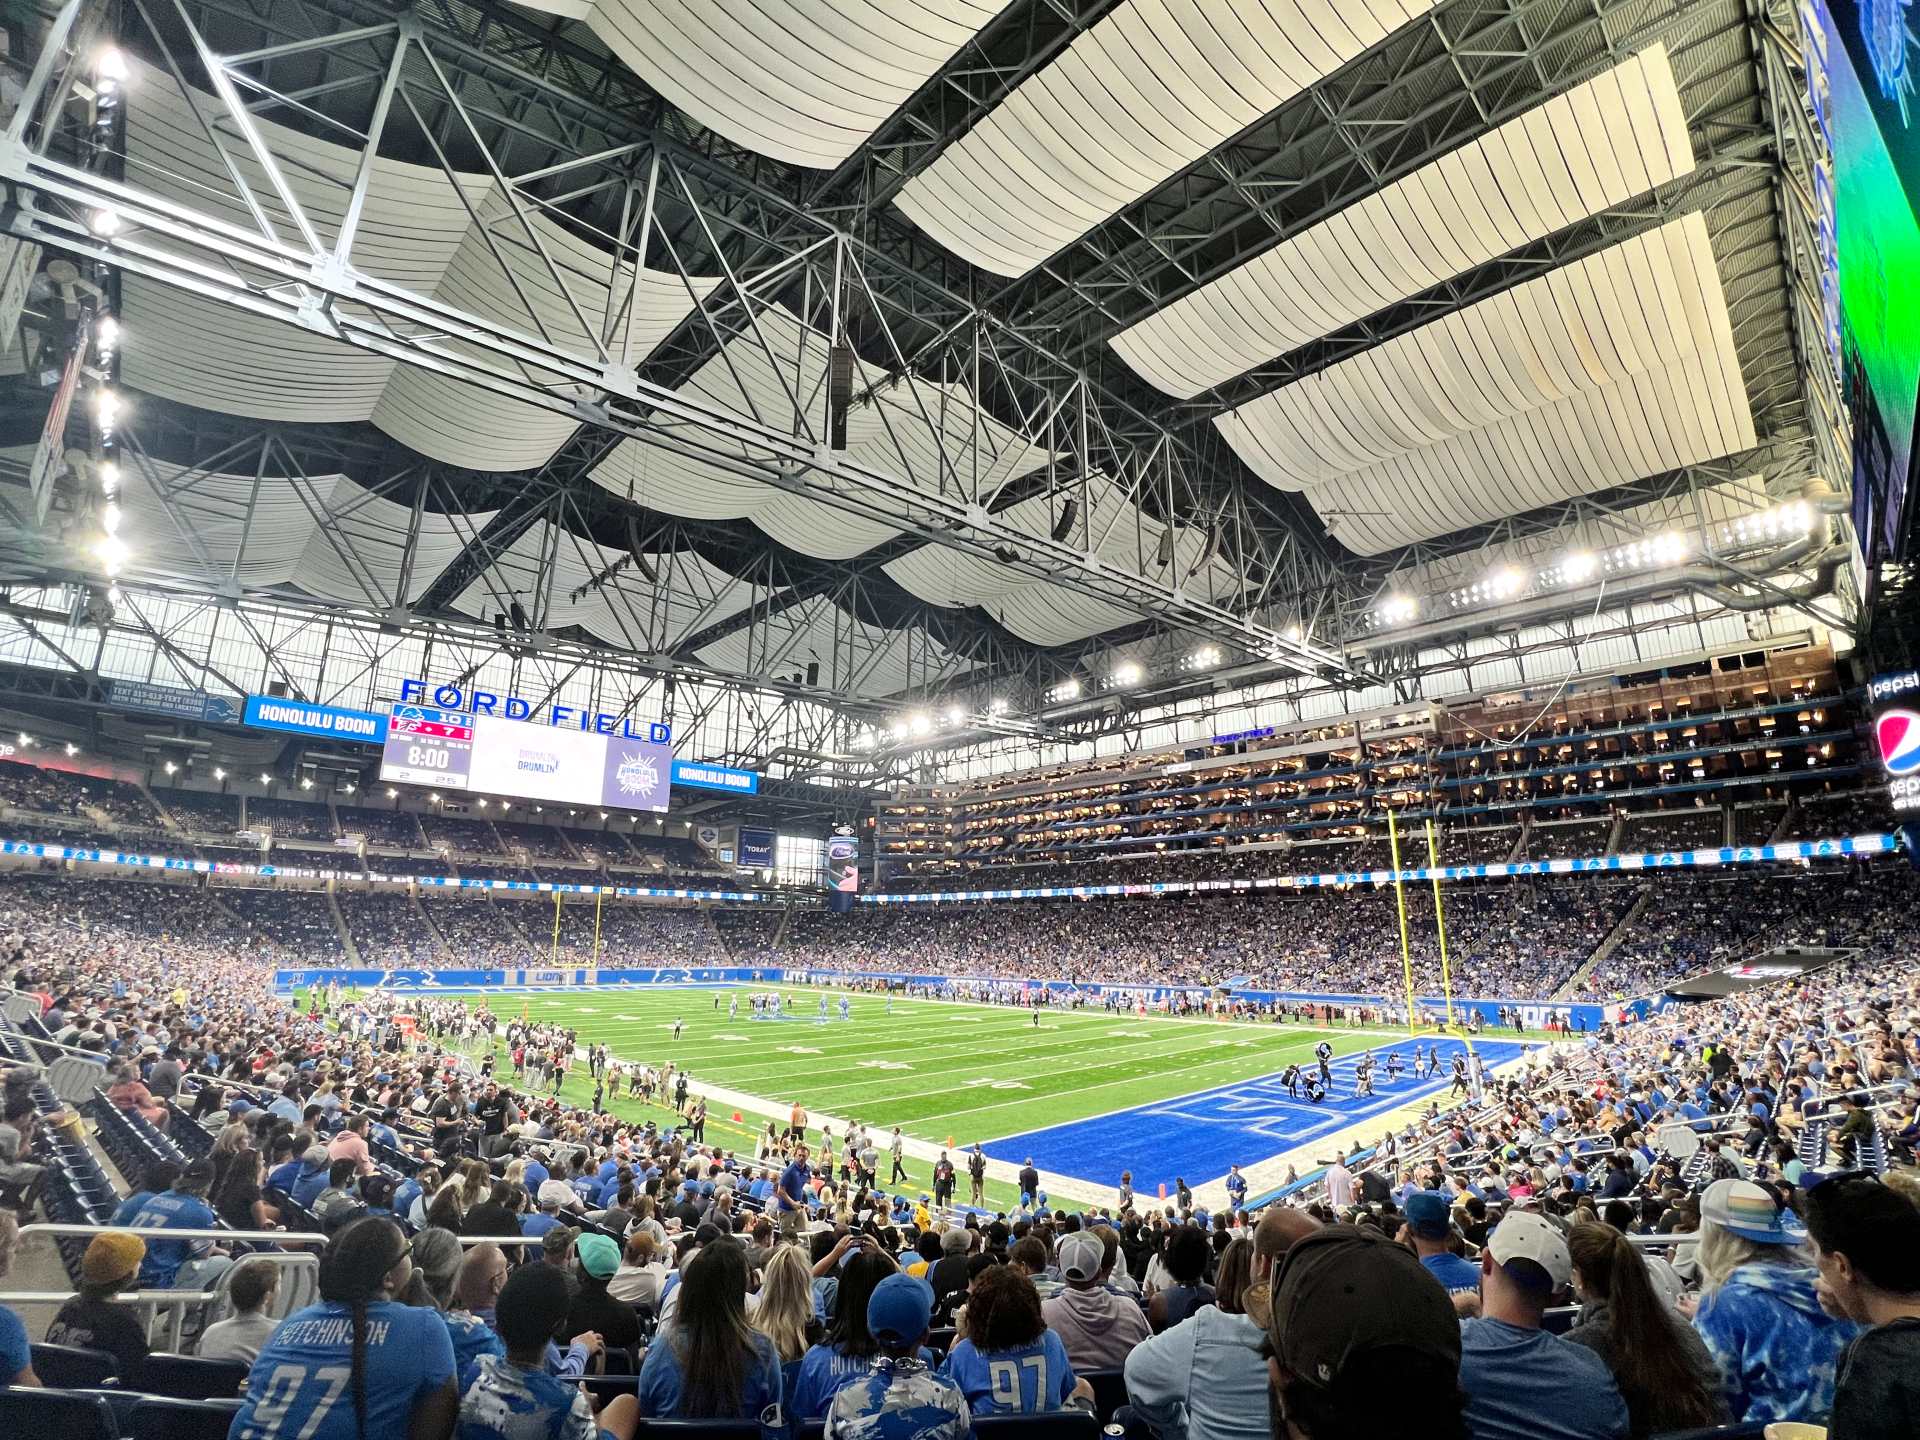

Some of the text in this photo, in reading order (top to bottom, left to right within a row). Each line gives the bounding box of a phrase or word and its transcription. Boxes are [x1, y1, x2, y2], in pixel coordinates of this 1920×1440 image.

[113, 686, 132, 697] TEXT
[1874, 670, 1920, 699] pepsi
[258, 704, 376, 735] HONOLULU BOOM
[400, 678, 673, 745] FORD FIELD
[440, 713, 462, 724] 10
[442, 726, 456, 736] 7
[407, 746, 450, 769] 8:00
[678, 766, 751, 788] HONOLULU BOOM
[1889, 776, 1920, 799] pep
[535, 971, 561, 982] LION
[989, 1354, 1047, 1414] 97
[240, 1364, 353, 1440] 97
